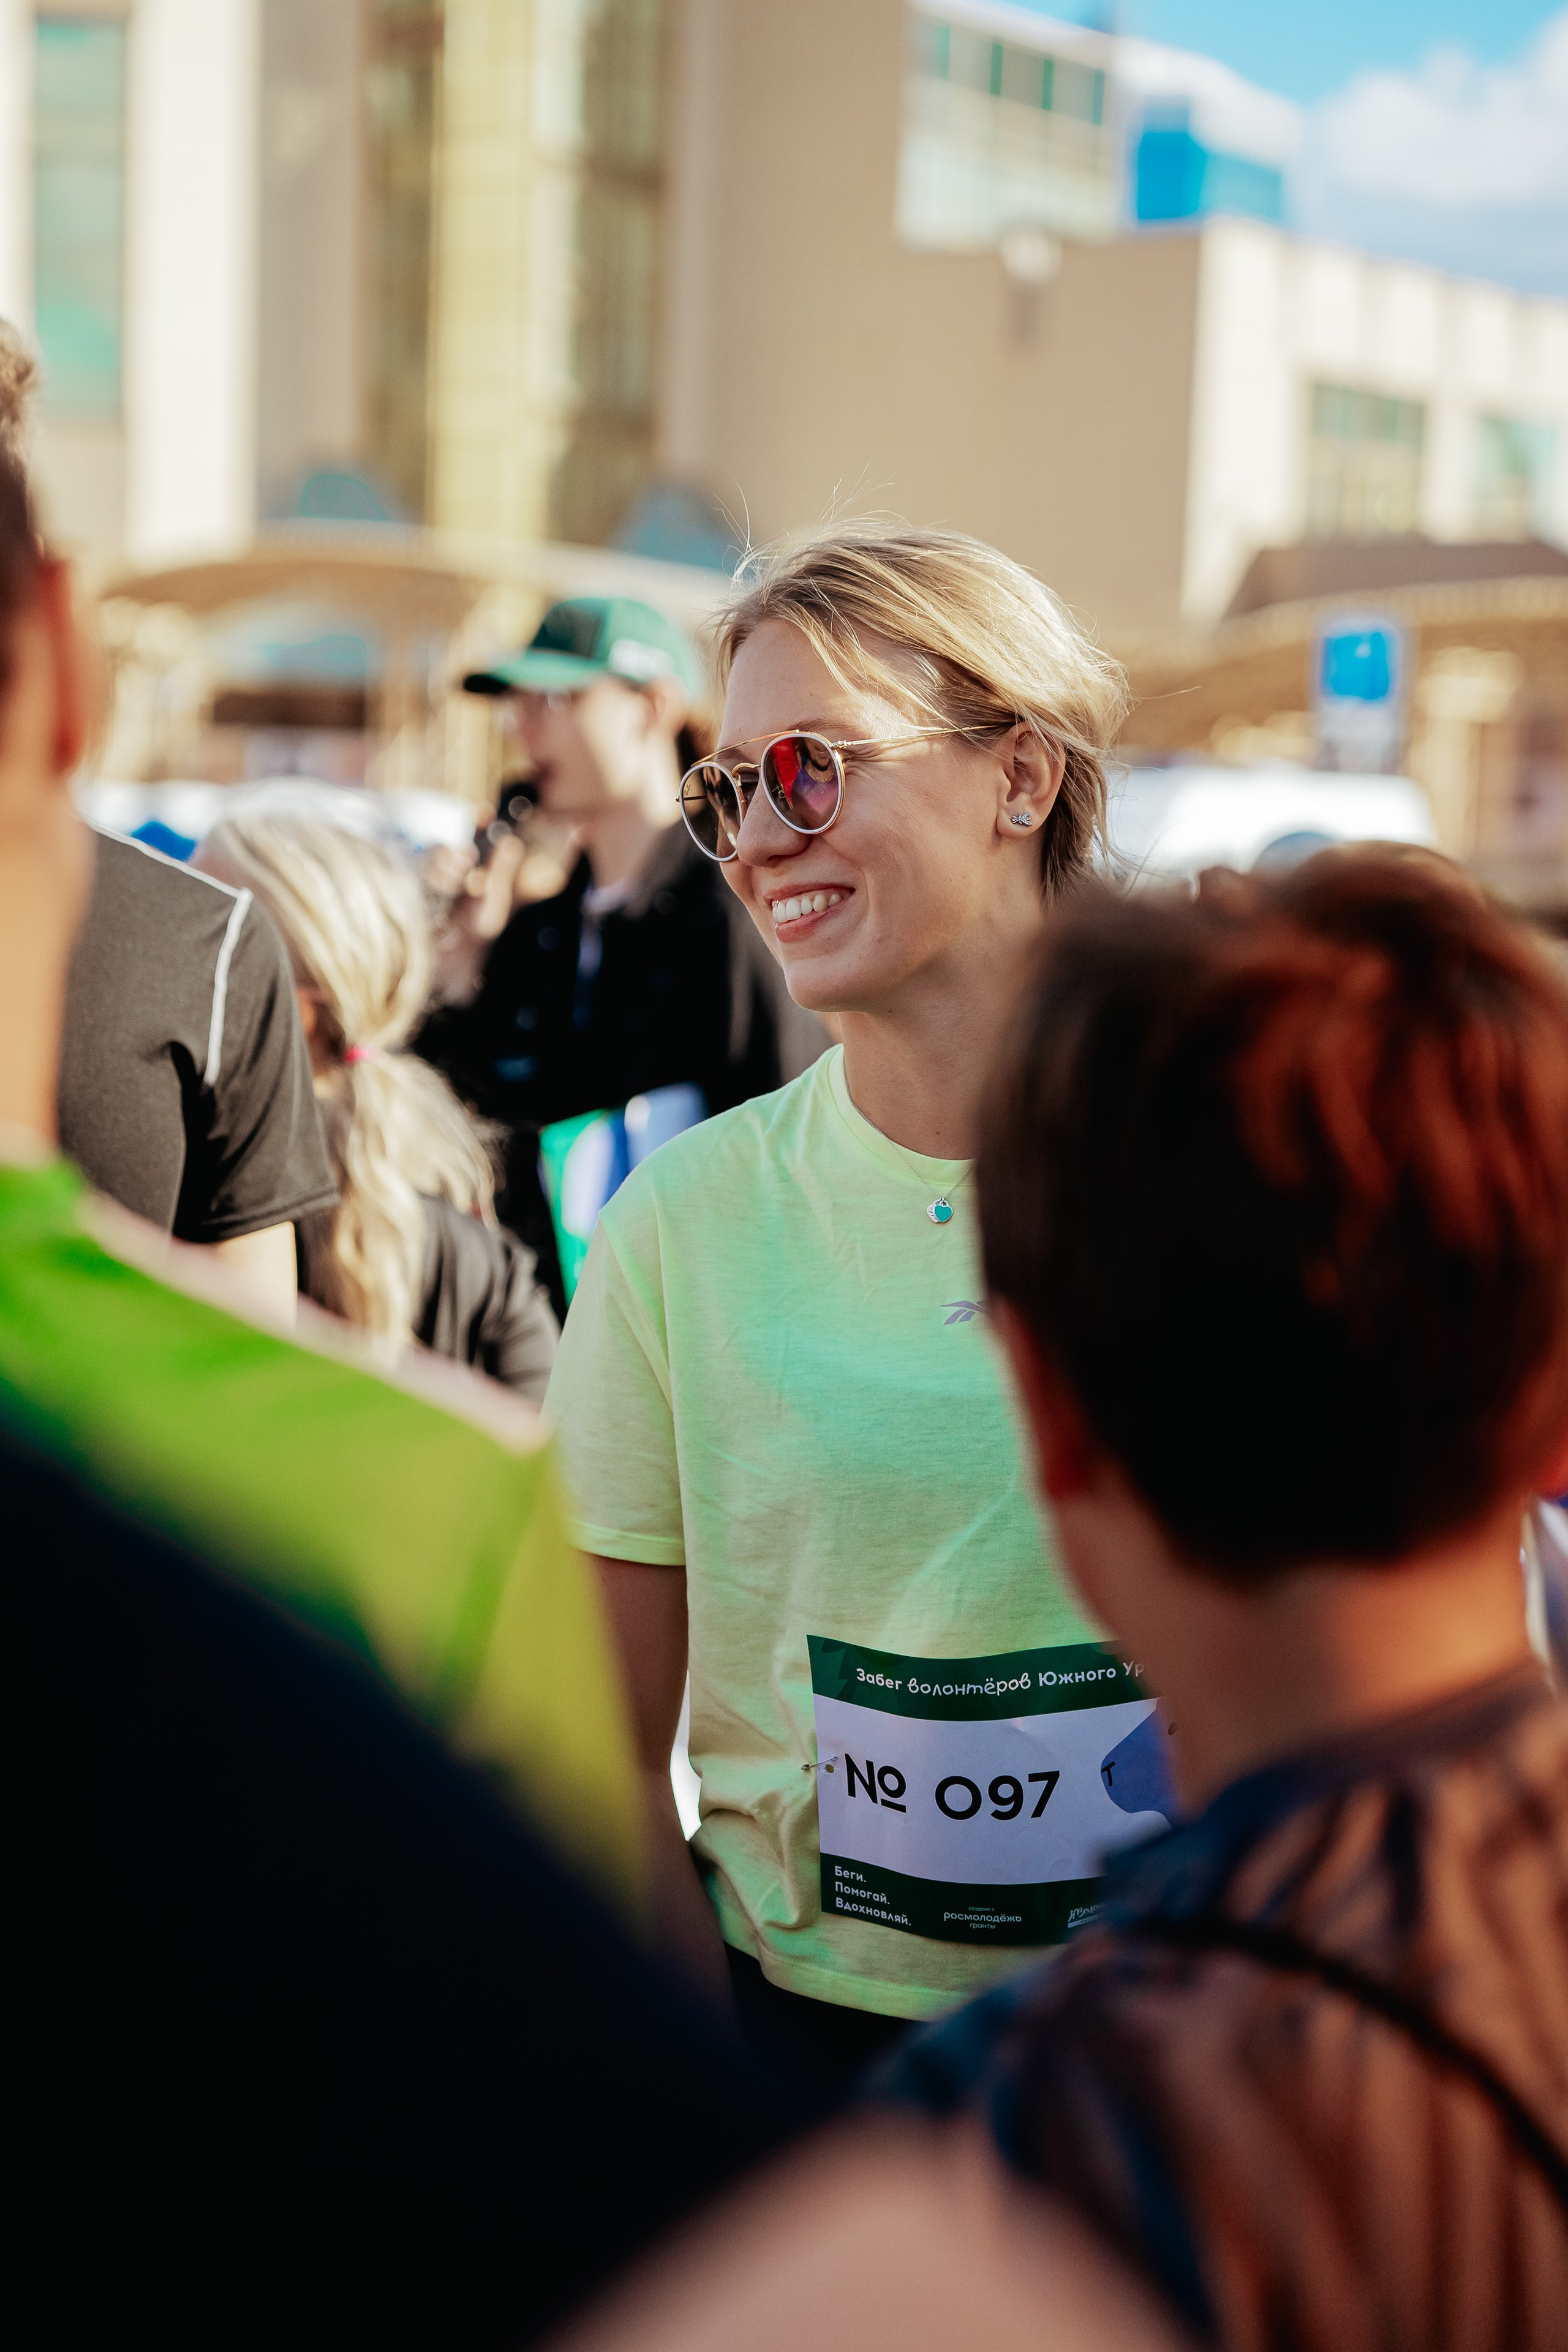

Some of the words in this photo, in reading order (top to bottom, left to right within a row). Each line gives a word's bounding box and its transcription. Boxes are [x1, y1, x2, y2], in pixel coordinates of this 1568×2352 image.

[856, 1668, 902, 1690] Забег
[907, 1672, 1031, 1696] волонтёров
[1039, 1668, 1116, 1686] Южного
[935, 1770, 1060, 1821] 097
[835, 1866, 866, 1883] Беги.
[835, 1881, 890, 1905] Помогай.
[836, 1897, 911, 1926] Вдохновляй.
